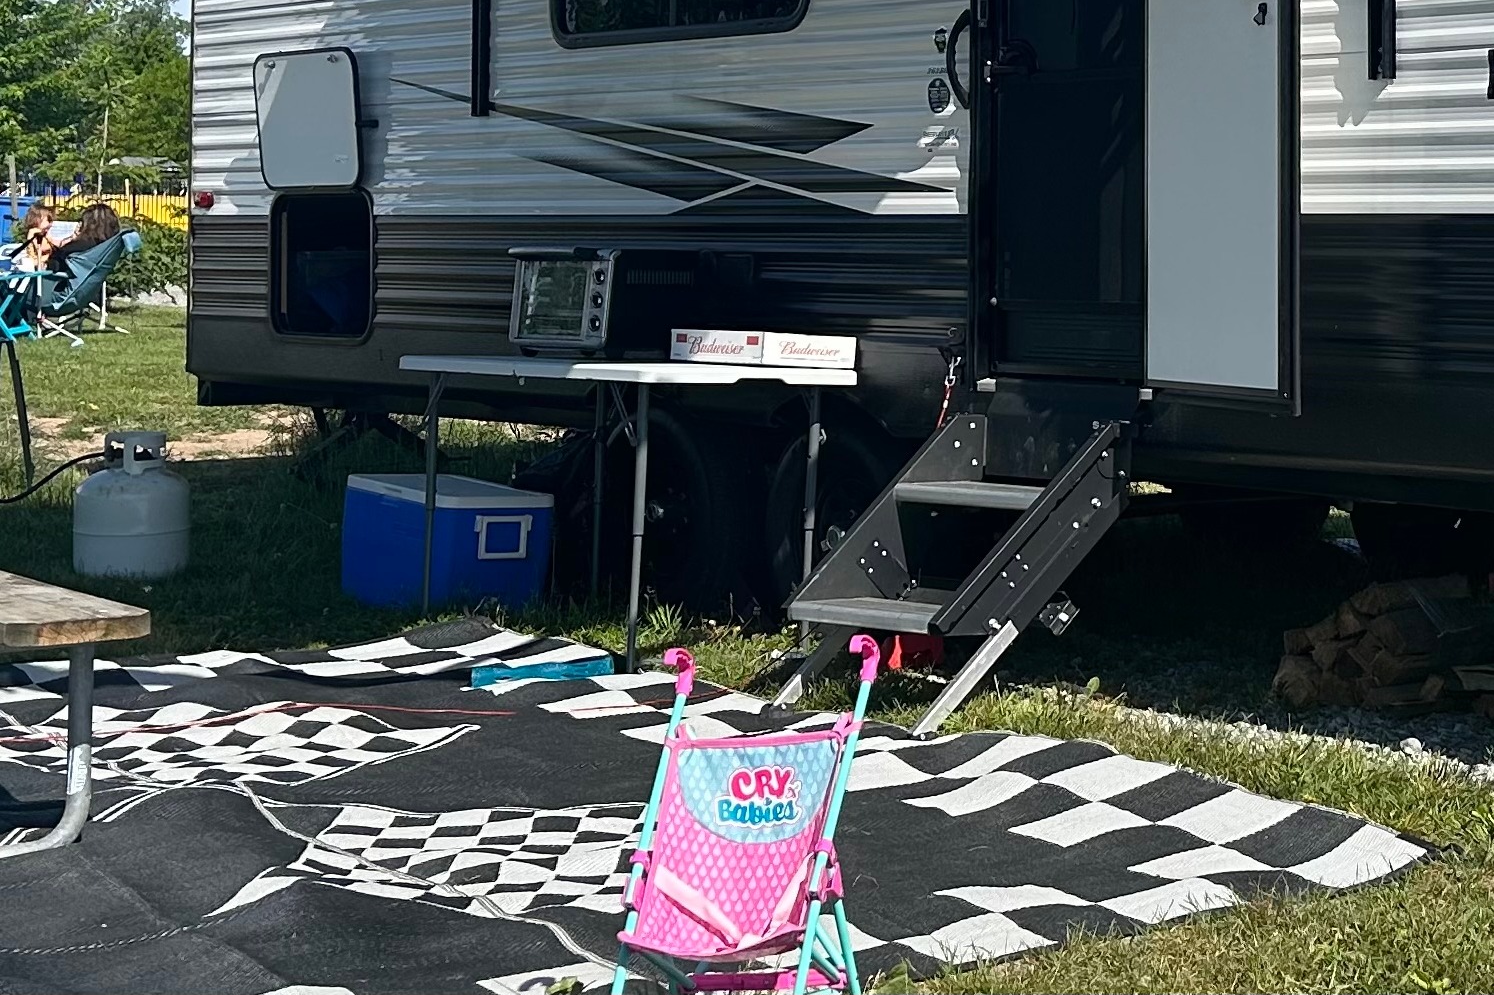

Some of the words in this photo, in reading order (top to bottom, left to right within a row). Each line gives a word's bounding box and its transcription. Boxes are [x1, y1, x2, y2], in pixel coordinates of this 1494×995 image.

[688, 335, 745, 356] Budweiser
[779, 340, 841, 357] Budweiser
[731, 769, 792, 800] CRY
[717, 797, 798, 825] Babies
